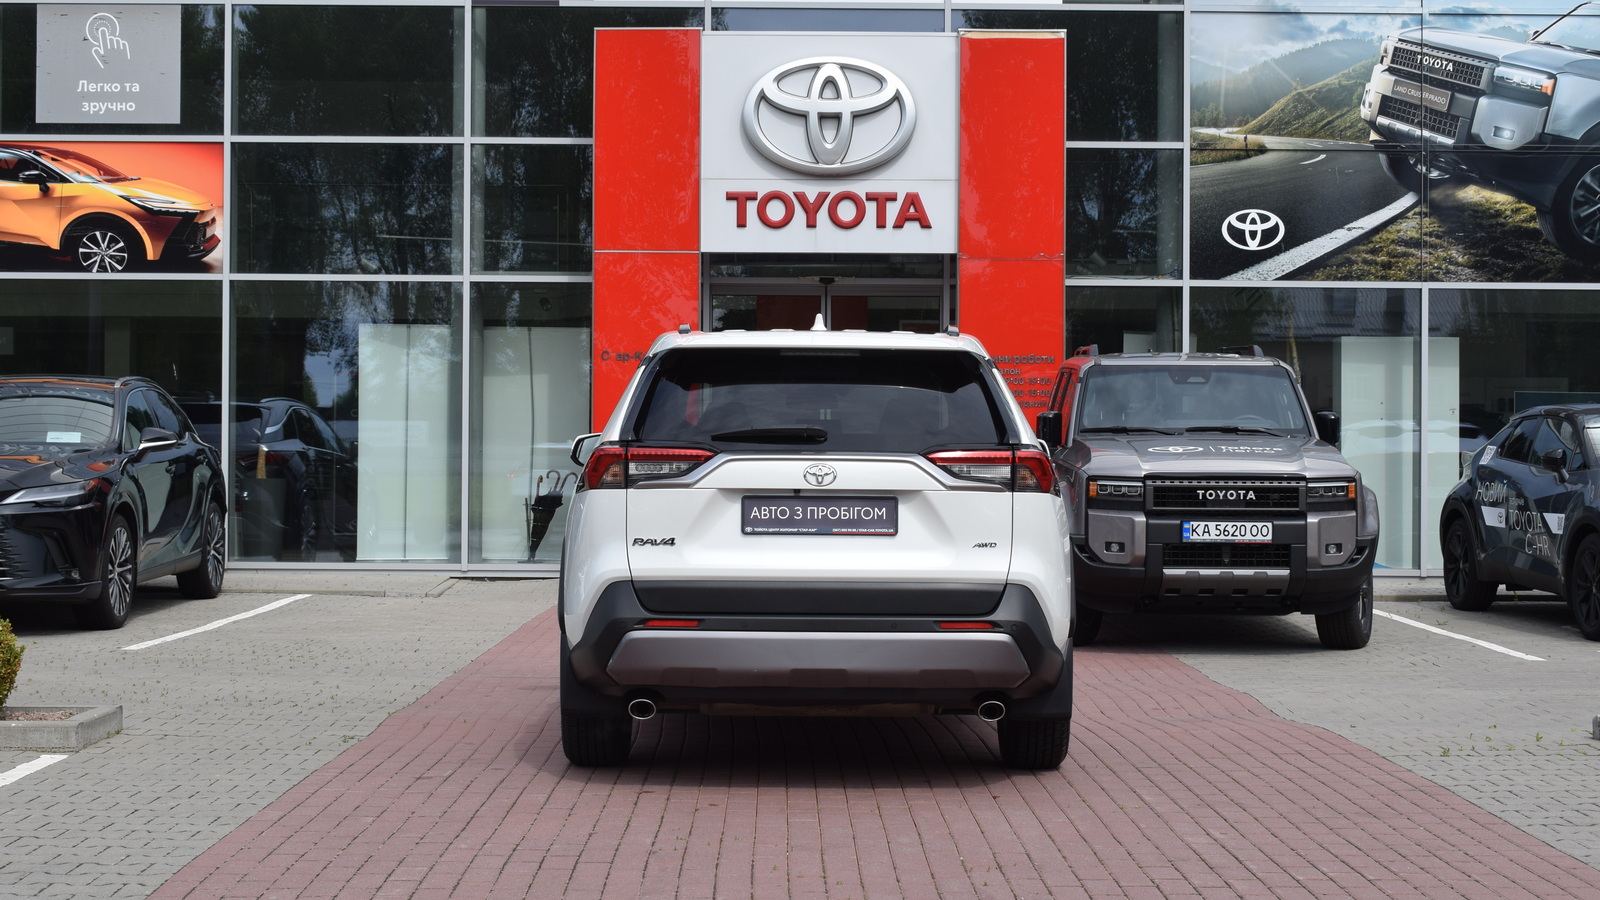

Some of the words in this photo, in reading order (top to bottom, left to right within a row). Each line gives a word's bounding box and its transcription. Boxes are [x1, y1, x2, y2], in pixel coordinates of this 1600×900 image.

[1417, 55, 1453, 71] TOYOTA
[76, 79, 121, 93] Легко
[123, 82, 140, 93] та
[1394, 84, 1407, 94] LAND
[1407, 89, 1430, 99] CRUISER
[1429, 93, 1446, 104] PRADO
[81, 101, 136, 115] зручно
[726, 190, 932, 229] TOYOTA
[1013, 354, 1055, 365] роботи
[1196, 490, 1256, 500] TOYOTA
[1475, 479, 1508, 503] НОВИЙ
[750, 506, 790, 520] АВТО
[807, 506, 887, 520] ПРОБІГОМ
[1508, 509, 1545, 533] TOYOTA
[1191, 523, 1211, 538] KA
[1214, 524, 1247, 538] 5620
[1250, 524, 1270, 538] OO
[631, 537, 676, 547] RAV4
[1525, 533, 1551, 557] C-HR
